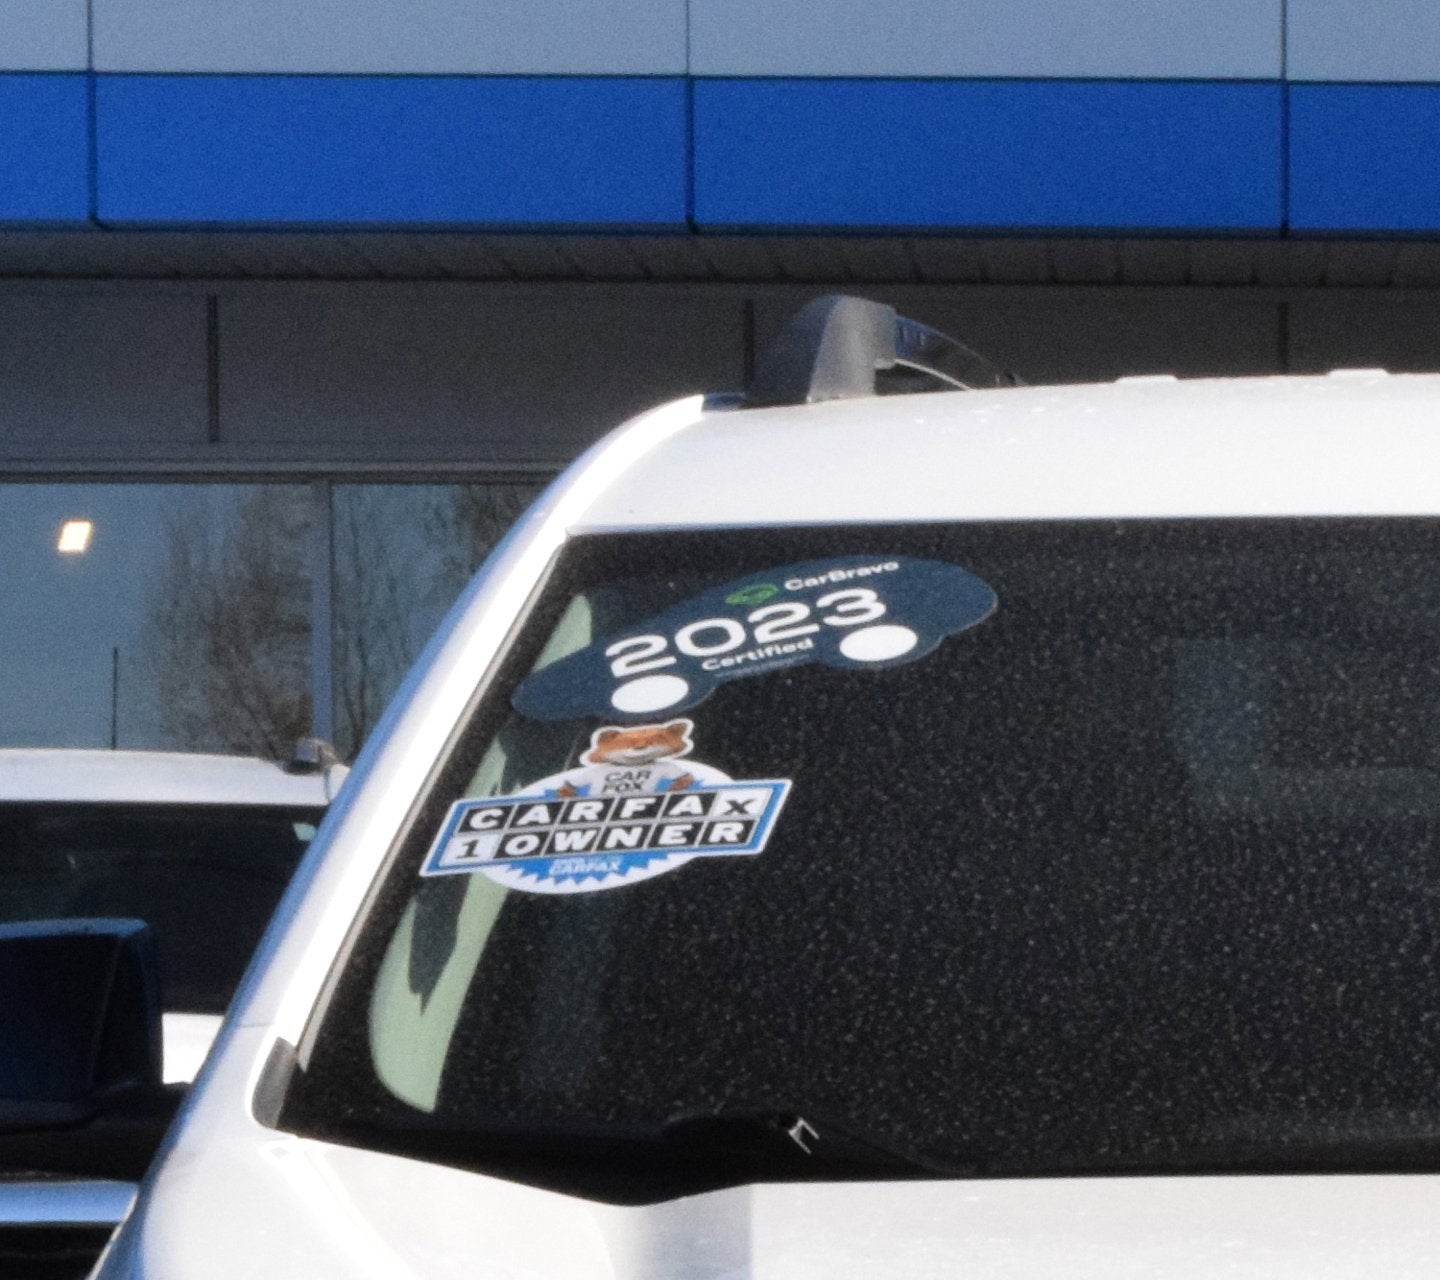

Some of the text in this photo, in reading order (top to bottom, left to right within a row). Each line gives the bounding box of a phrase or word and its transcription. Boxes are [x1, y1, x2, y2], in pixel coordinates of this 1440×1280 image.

[784, 561, 899, 591] CarBravo
[606, 588, 886, 678] 2023
[701, 638, 813, 670] Certified
[469, 793, 756, 830] CARFAX
